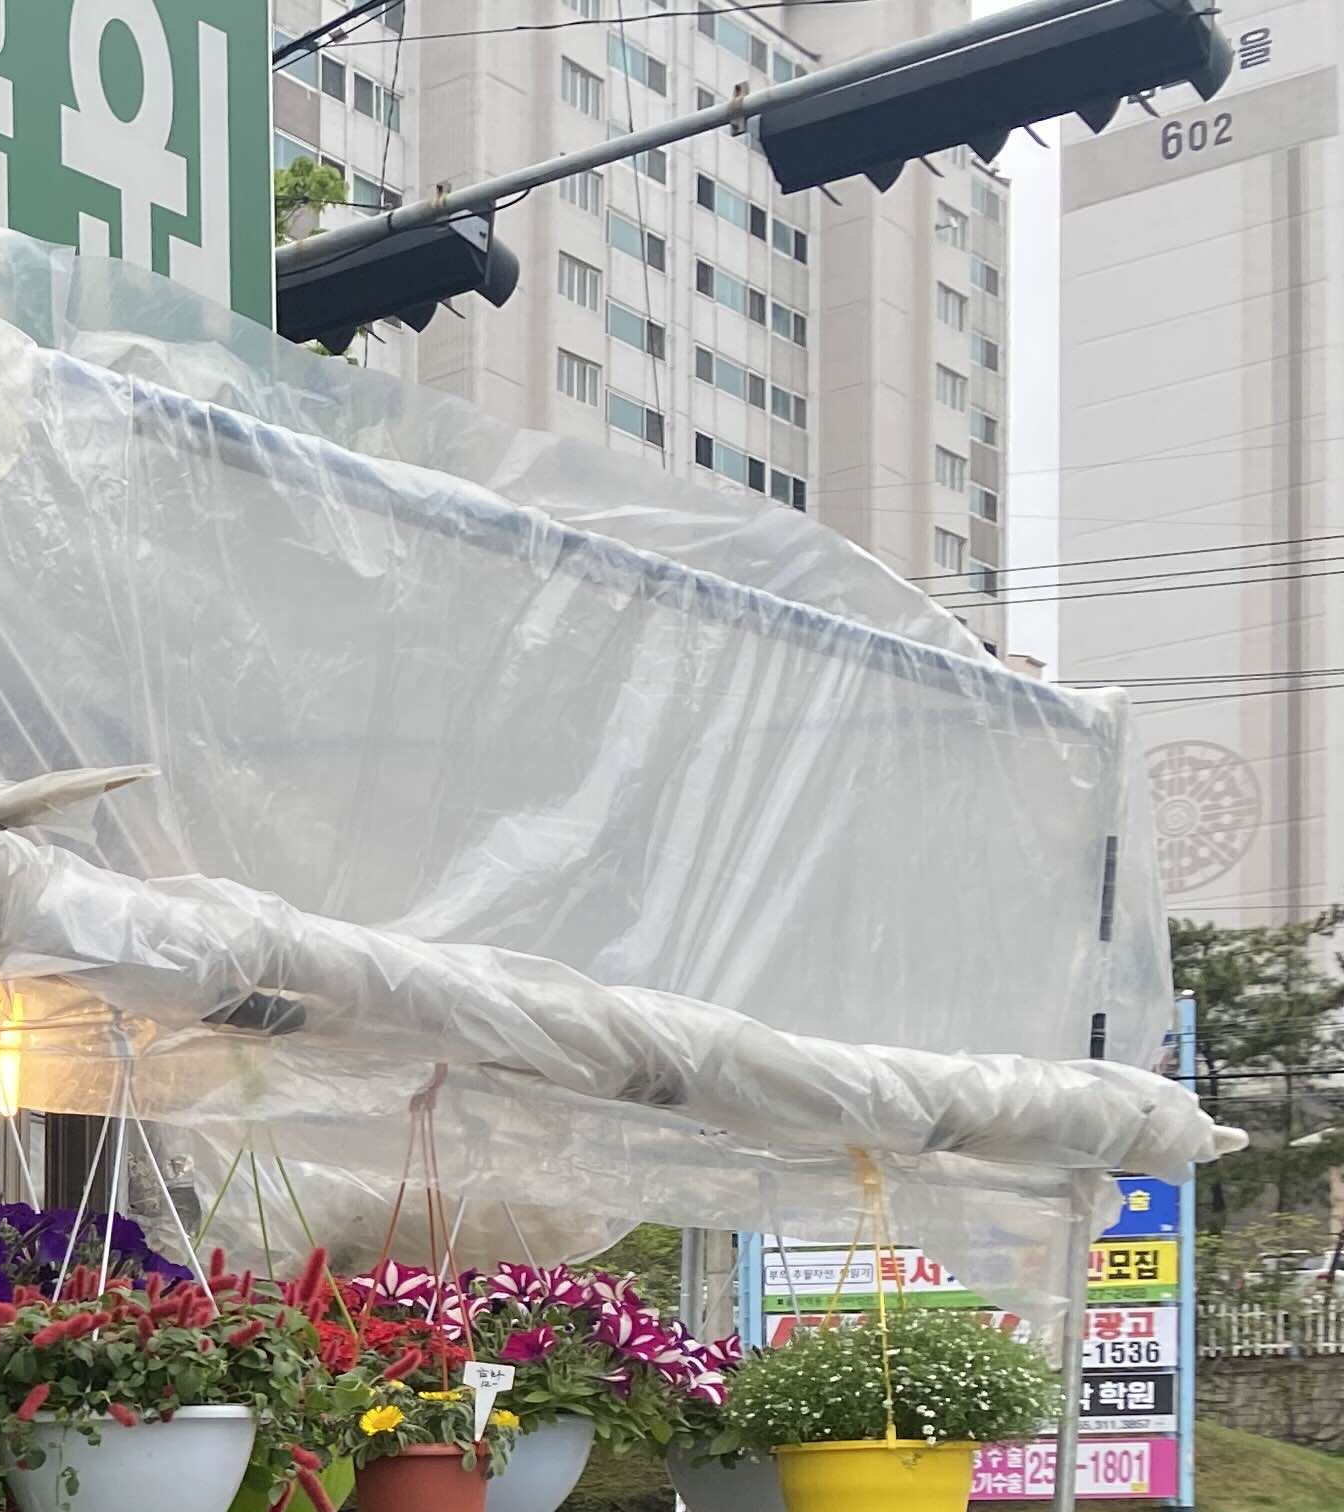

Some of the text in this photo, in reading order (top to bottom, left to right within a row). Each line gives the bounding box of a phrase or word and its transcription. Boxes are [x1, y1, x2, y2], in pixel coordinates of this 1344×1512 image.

[1162, 112, 1233, 160] 602
[879, 1256, 942, 1287] 독서
[1083, 1312, 1154, 1340] 광고
[1099, 1381, 1155, 1411] 학원
[969, 1472, 1023, 1493] 기수술
[1029, 1450, 1146, 1485] 25-1801
